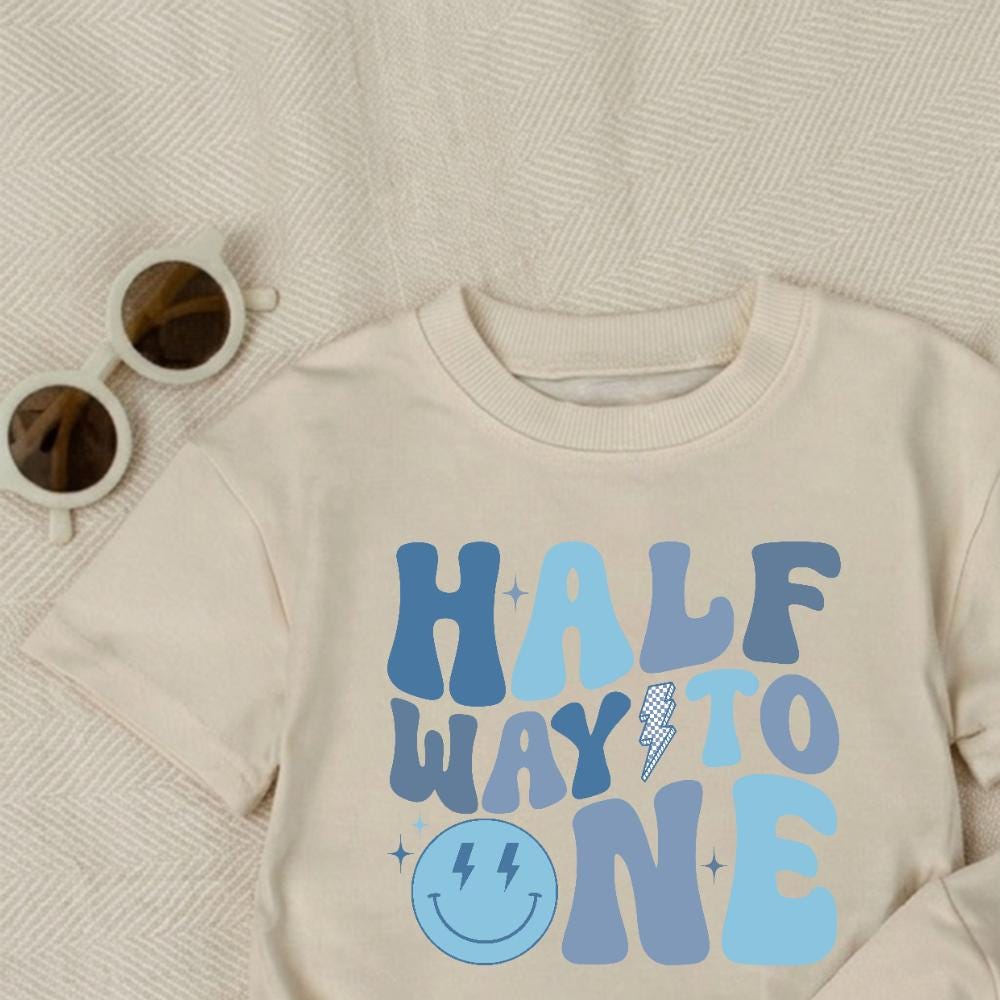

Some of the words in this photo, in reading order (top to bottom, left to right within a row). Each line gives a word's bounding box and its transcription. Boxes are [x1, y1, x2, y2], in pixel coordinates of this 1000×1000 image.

[387, 541, 841, 707] HALF
[390, 691, 631, 814] WAY
[685, 668, 840, 775] TO
